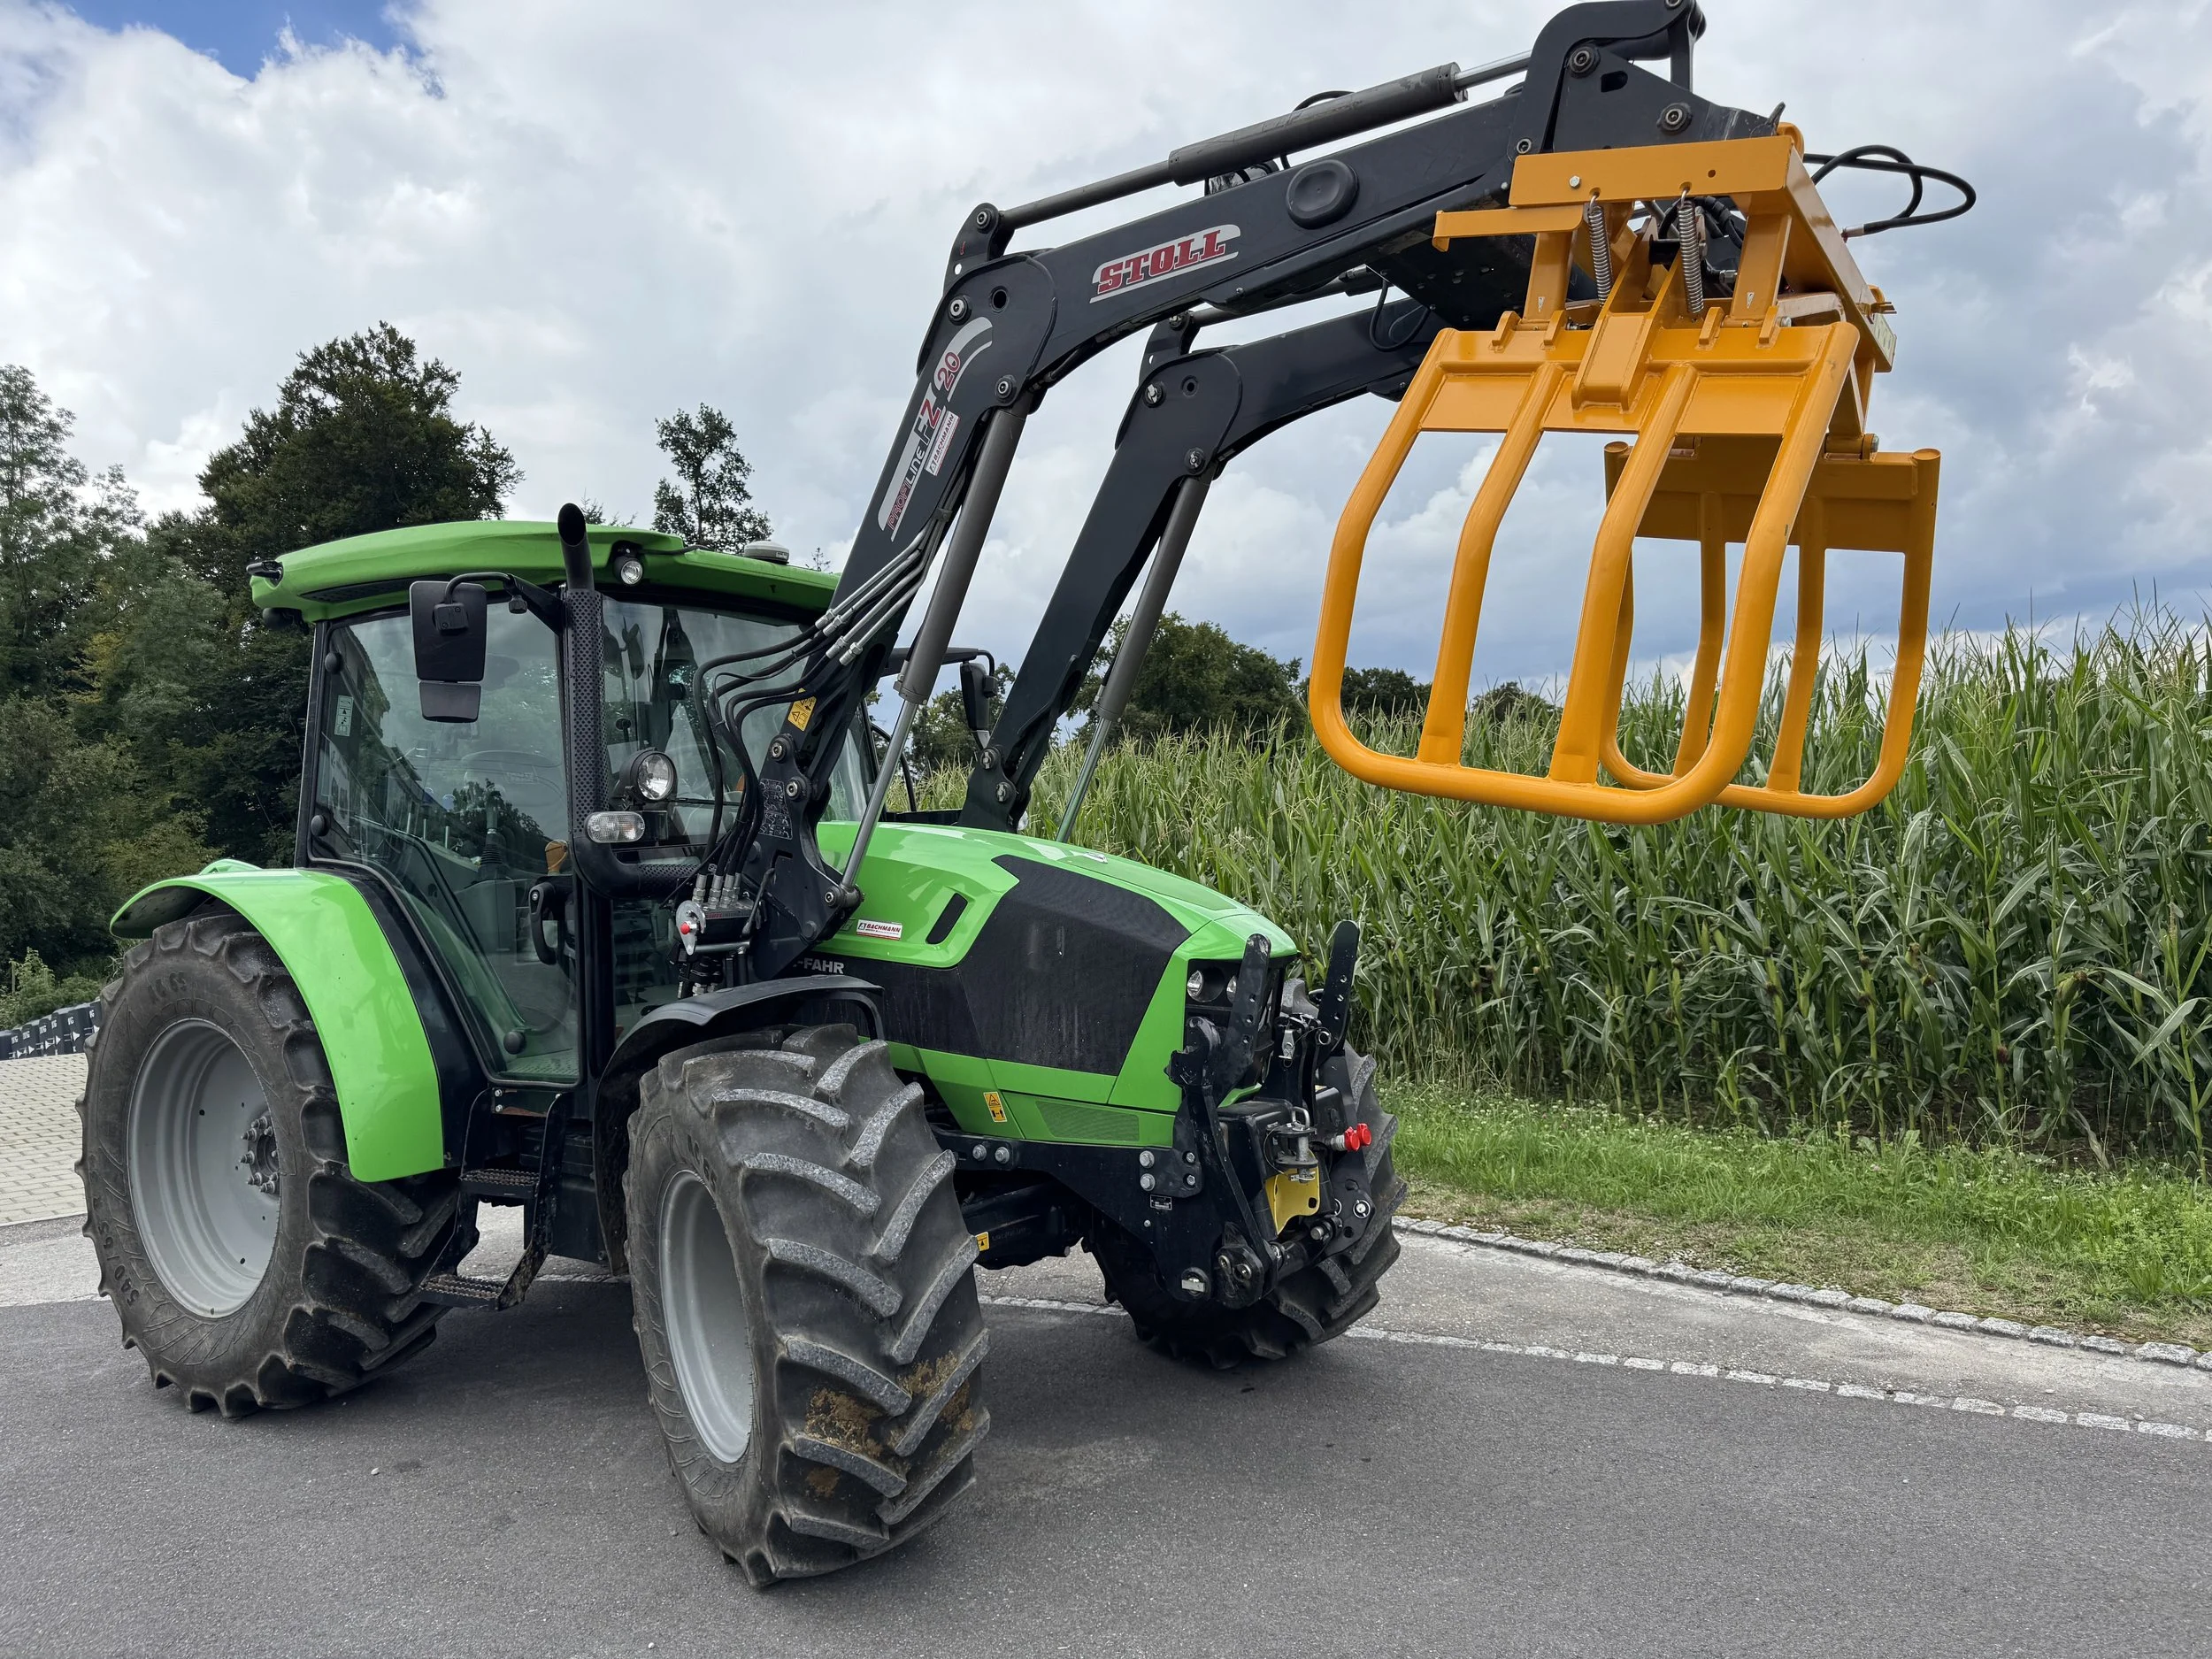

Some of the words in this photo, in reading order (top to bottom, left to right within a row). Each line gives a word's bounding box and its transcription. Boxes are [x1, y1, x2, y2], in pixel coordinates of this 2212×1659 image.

[1097, 230, 1225, 294] STOLL
[913, 398, 941, 446] FZ
[937, 351, 961, 392] 20
[933, 413, 955, 461] BACHMANN
[866, 923, 902, 933] BACHMANN
